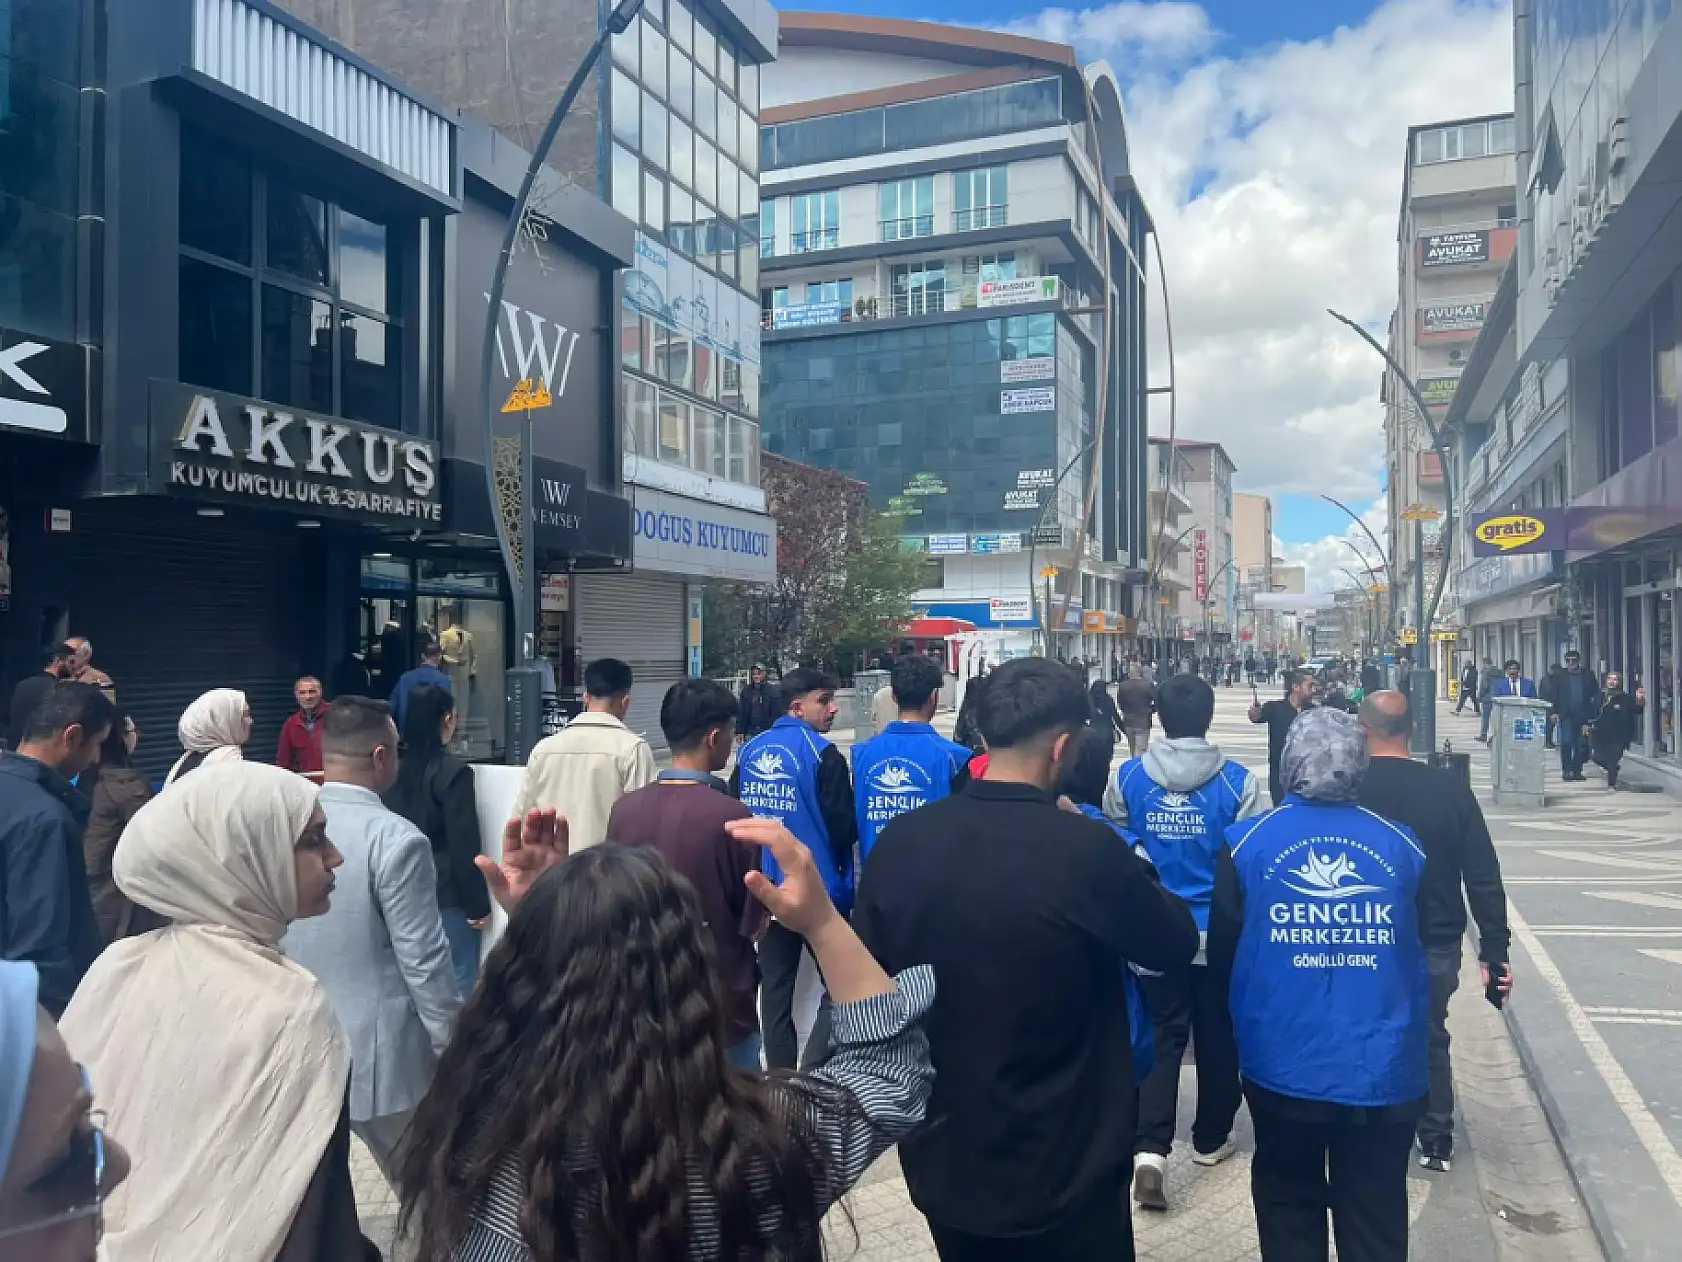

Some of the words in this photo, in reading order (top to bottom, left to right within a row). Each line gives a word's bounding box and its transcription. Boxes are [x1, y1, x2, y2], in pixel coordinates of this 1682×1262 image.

[1428, 244, 1481, 258] AVUKAT
[1428, 304, 1482, 318] AVUKAT
[173, 393, 436, 497] AKKUŞ
[171, 461, 323, 506] KUYUMCULUK
[347, 489, 443, 522] SARRAFİYE
[697, 519, 770, 559] KUYUMCU
[1483, 518, 1538, 540] gratis
[1269, 900, 1394, 926] GENÇLİK
[1293, 952, 1344, 968] GÖNÜLLÜ
[1347, 954, 1378, 970] GENÇ
